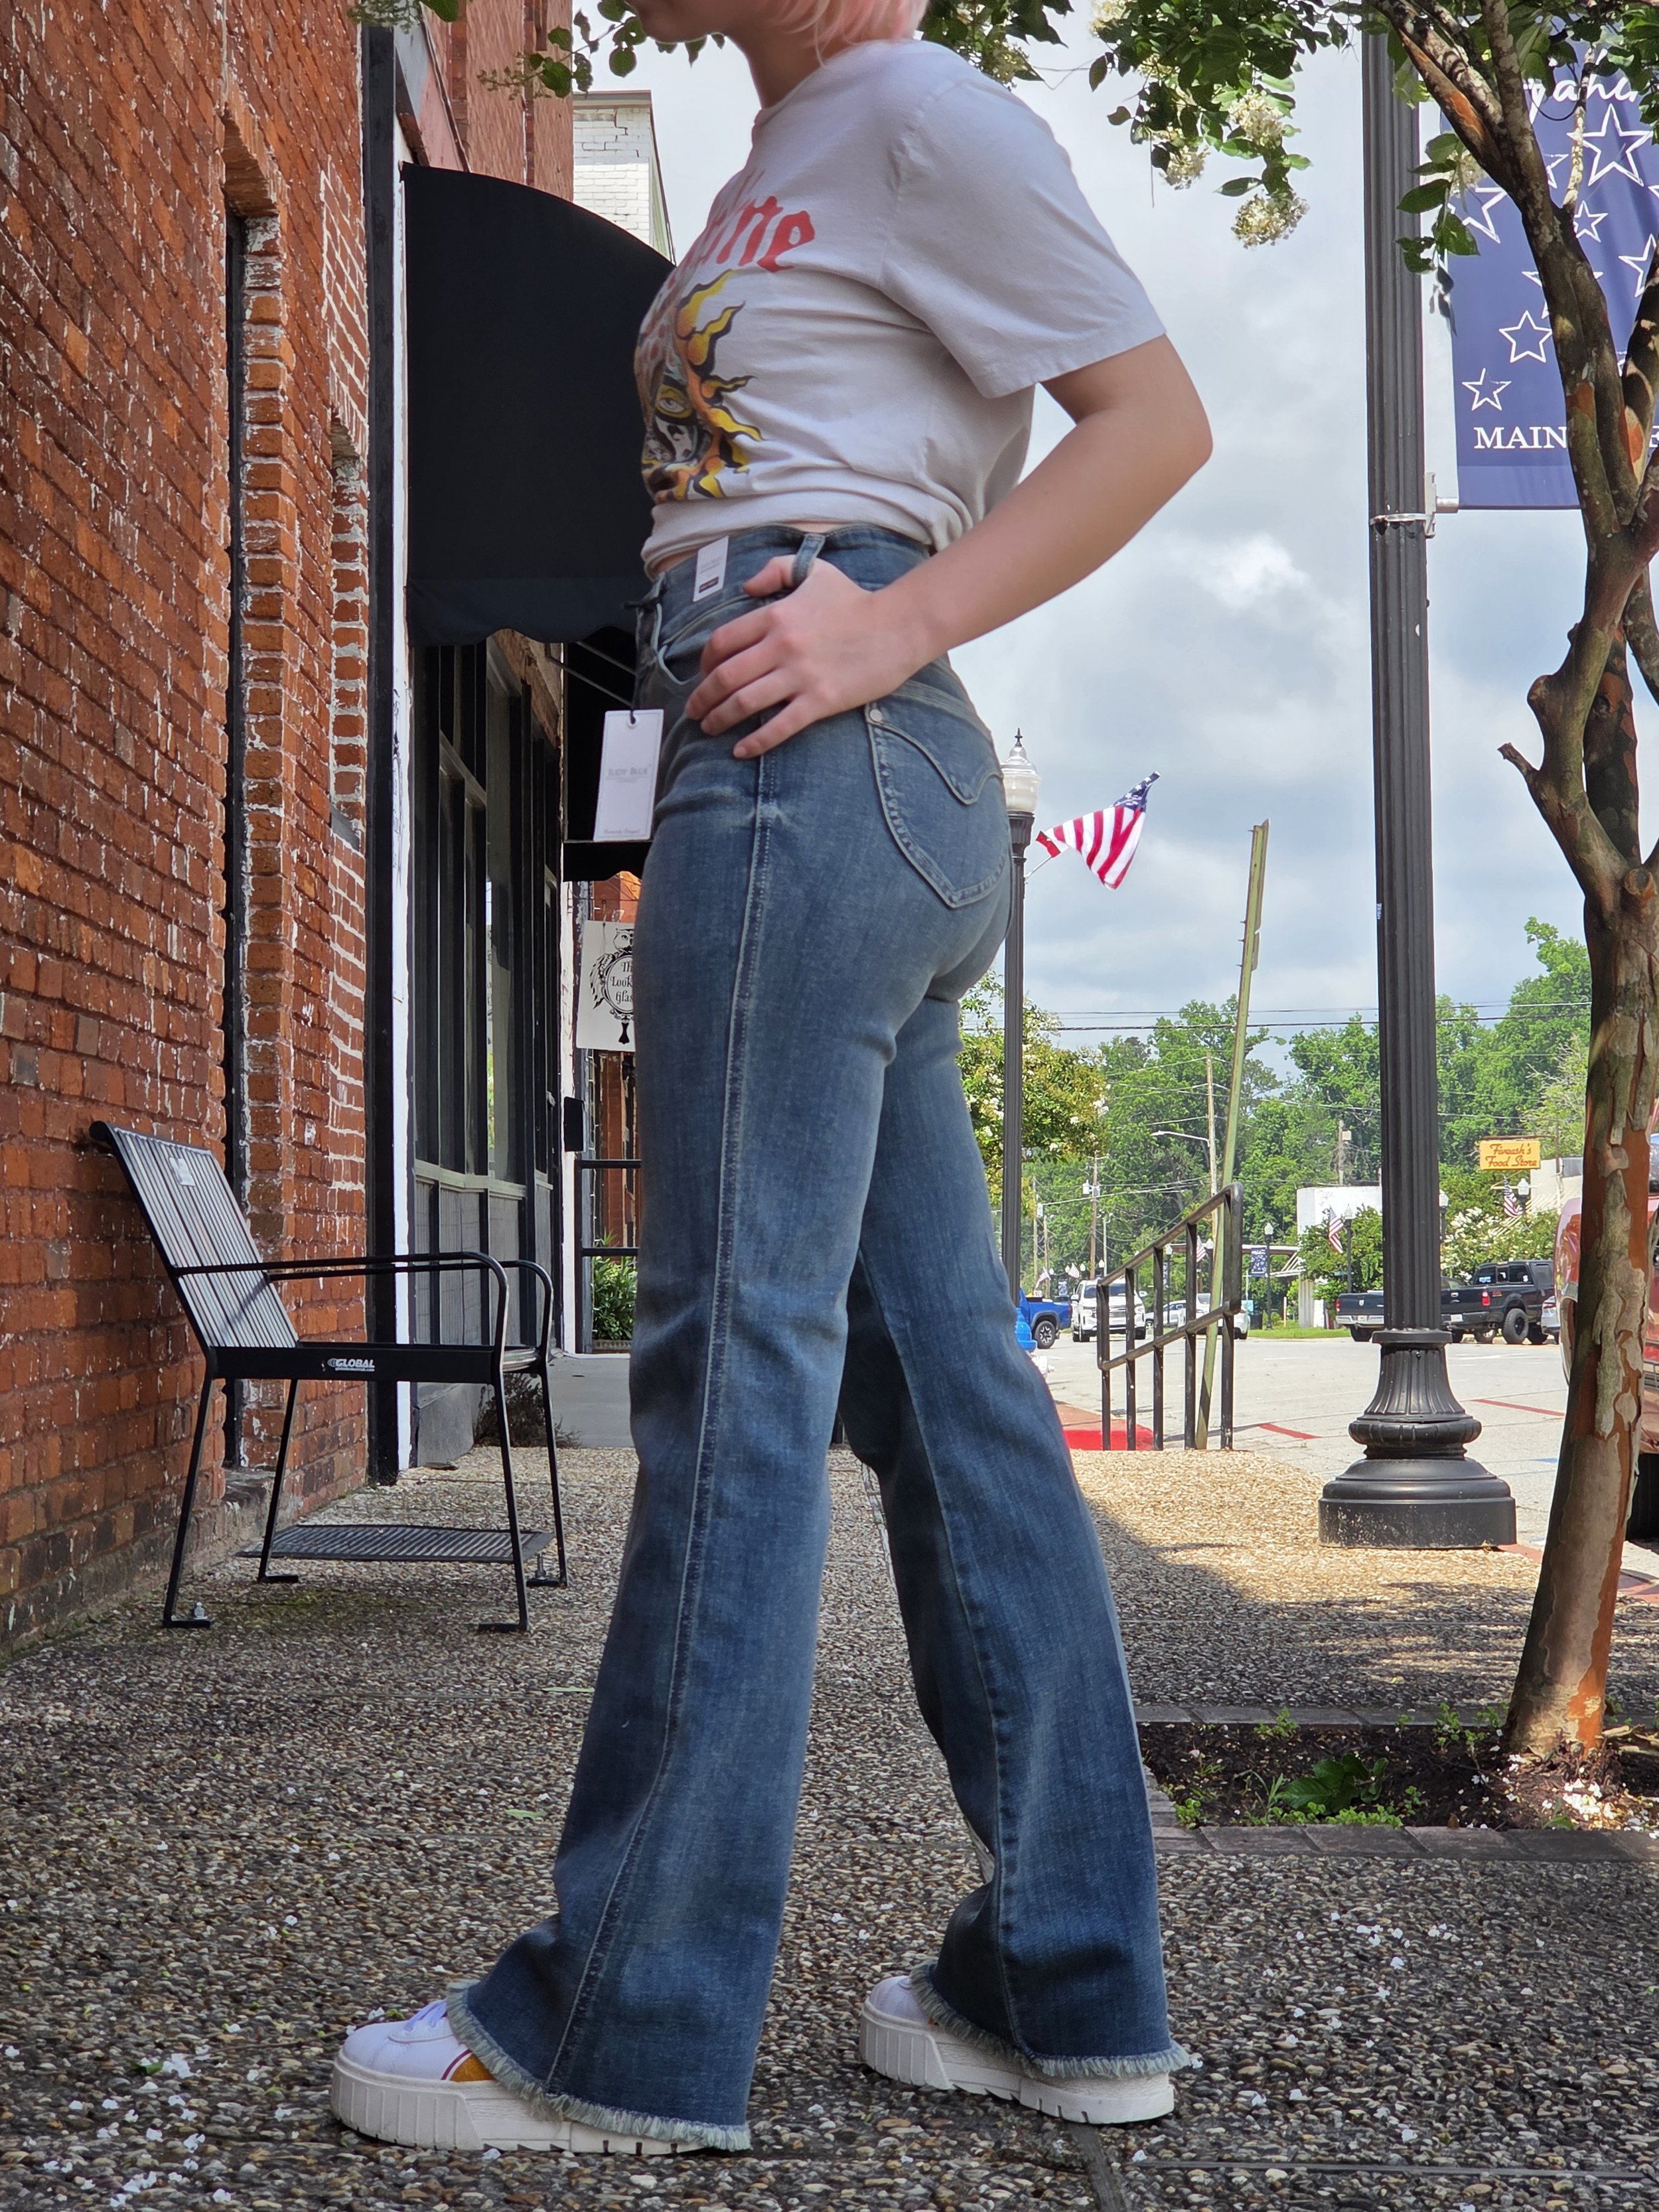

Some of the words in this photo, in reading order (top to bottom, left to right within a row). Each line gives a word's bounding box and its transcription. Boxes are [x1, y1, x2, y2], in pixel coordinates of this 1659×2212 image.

[1473, 426, 1567, 449] MAIN
[621, 961, 632, 972] Th
[610, 975, 632, 987] Look
[1485, 1155, 1510, 1167] Food
[1511, 1155, 1537, 1166] Store
[335, 1359, 375, 1368] GLOBAL
